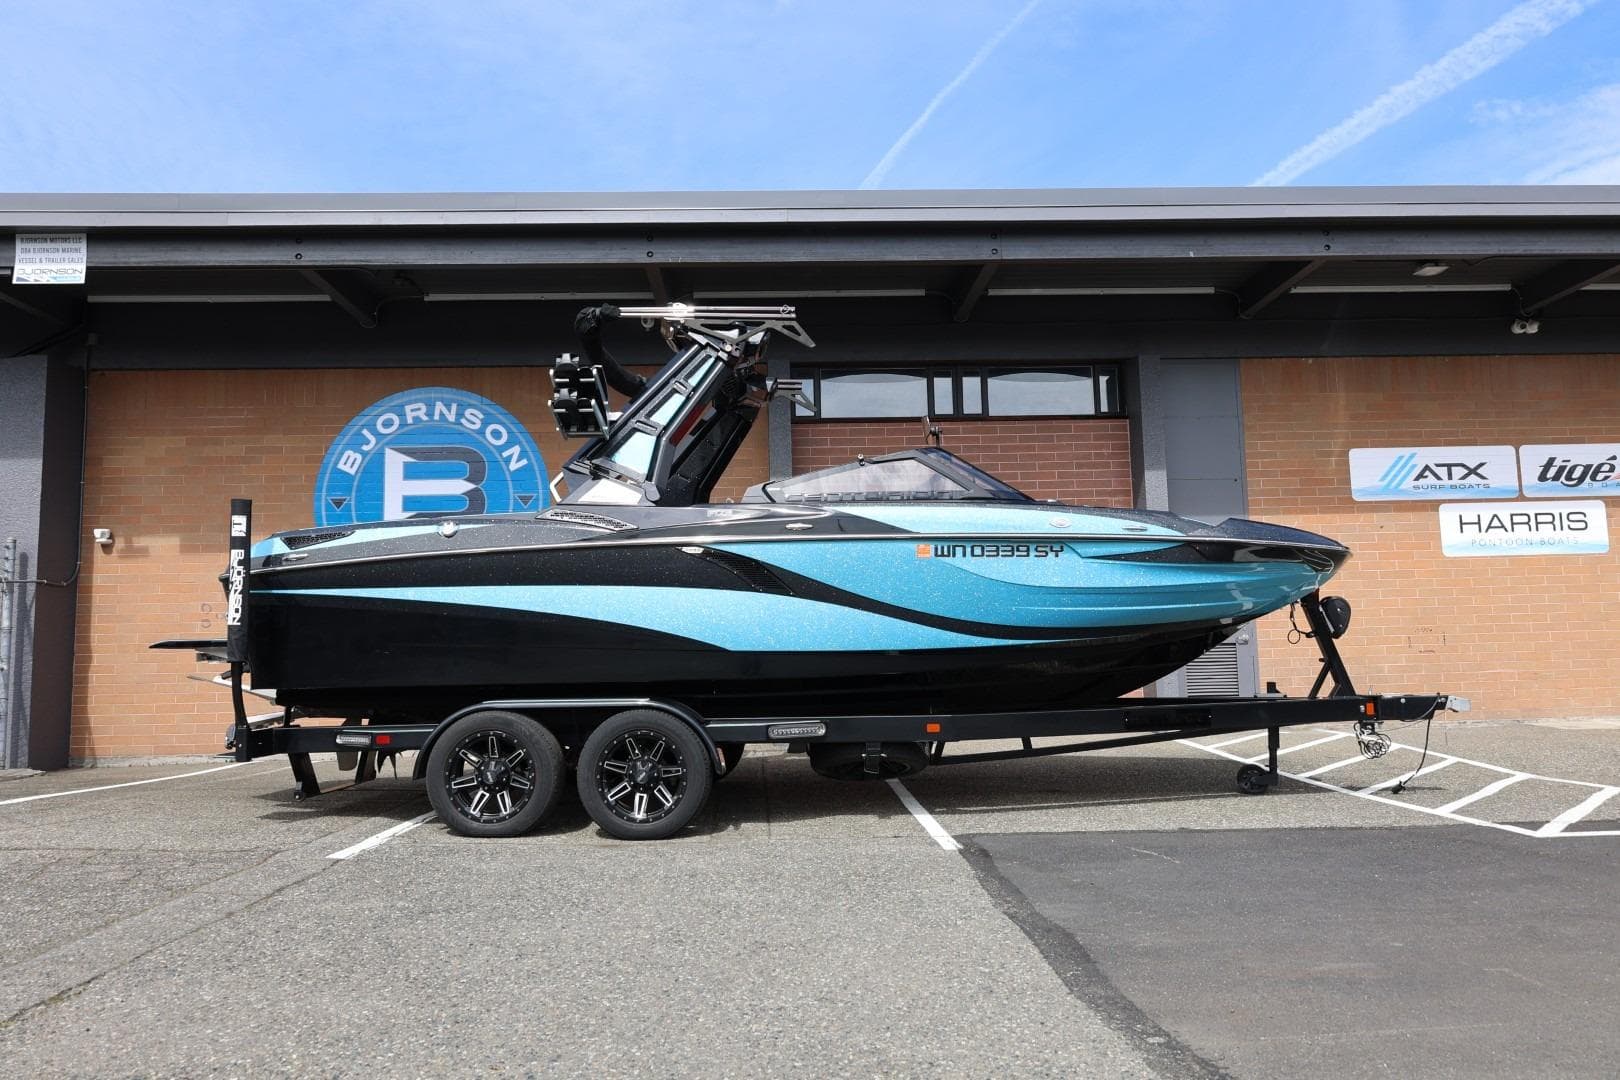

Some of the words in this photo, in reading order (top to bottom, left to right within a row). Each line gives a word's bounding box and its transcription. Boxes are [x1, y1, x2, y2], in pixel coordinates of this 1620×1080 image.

[337, 401, 528, 476] BJORNSON
[1412, 461, 1489, 481] ATX
[1537, 455, 1618, 487] tigé
[1459, 511, 1588, 533] HARRIS
[934, 544, 967, 558] WN
[970, 544, 1030, 558] 0339
[1034, 544, 1064, 558] SY
[1471, 537, 1533, 547] PONTOON
[1539, 536, 1579, 546] BOATS
